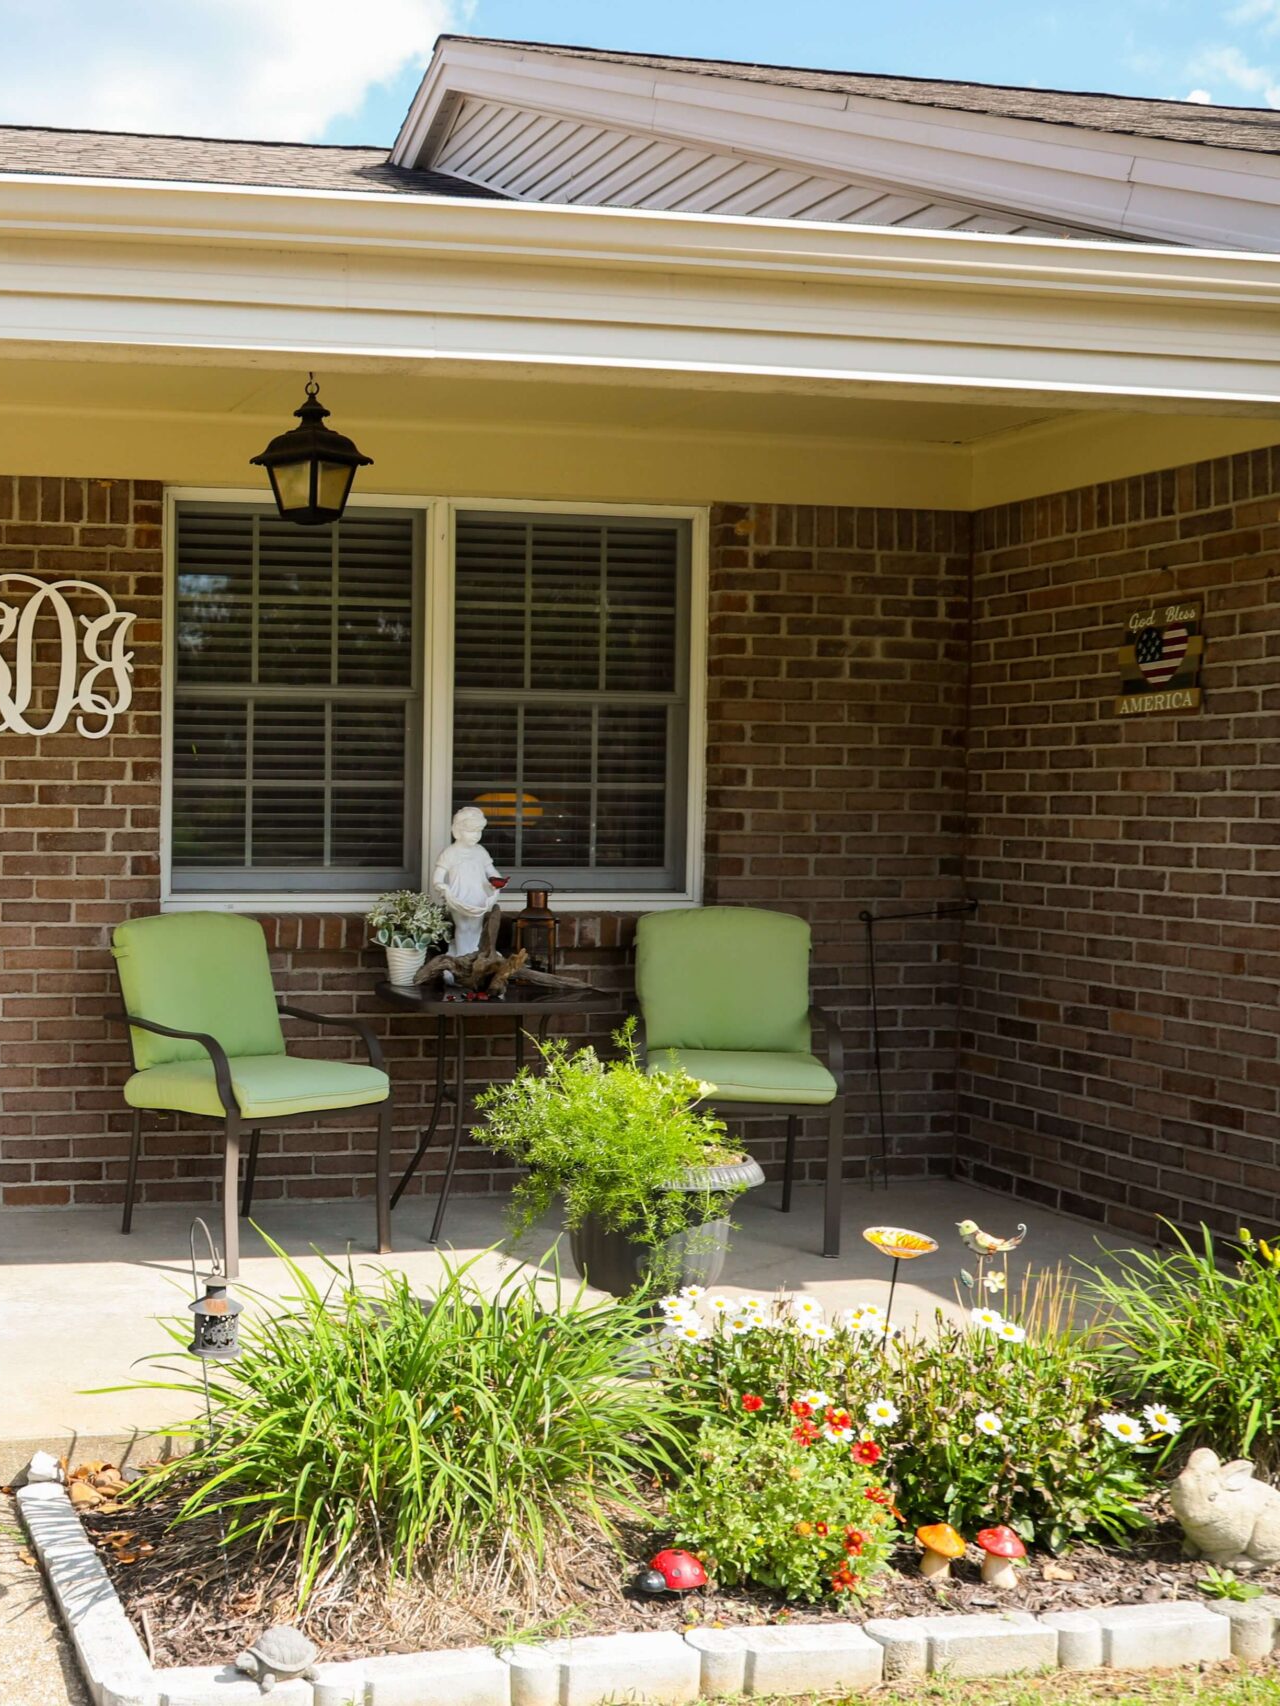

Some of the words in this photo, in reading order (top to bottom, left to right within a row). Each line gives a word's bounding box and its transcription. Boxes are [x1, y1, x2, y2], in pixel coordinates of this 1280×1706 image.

[1129, 610, 1156, 634] God
[1165, 605, 1196, 622] Bless
[1120, 691, 1192, 714] AMERICA
